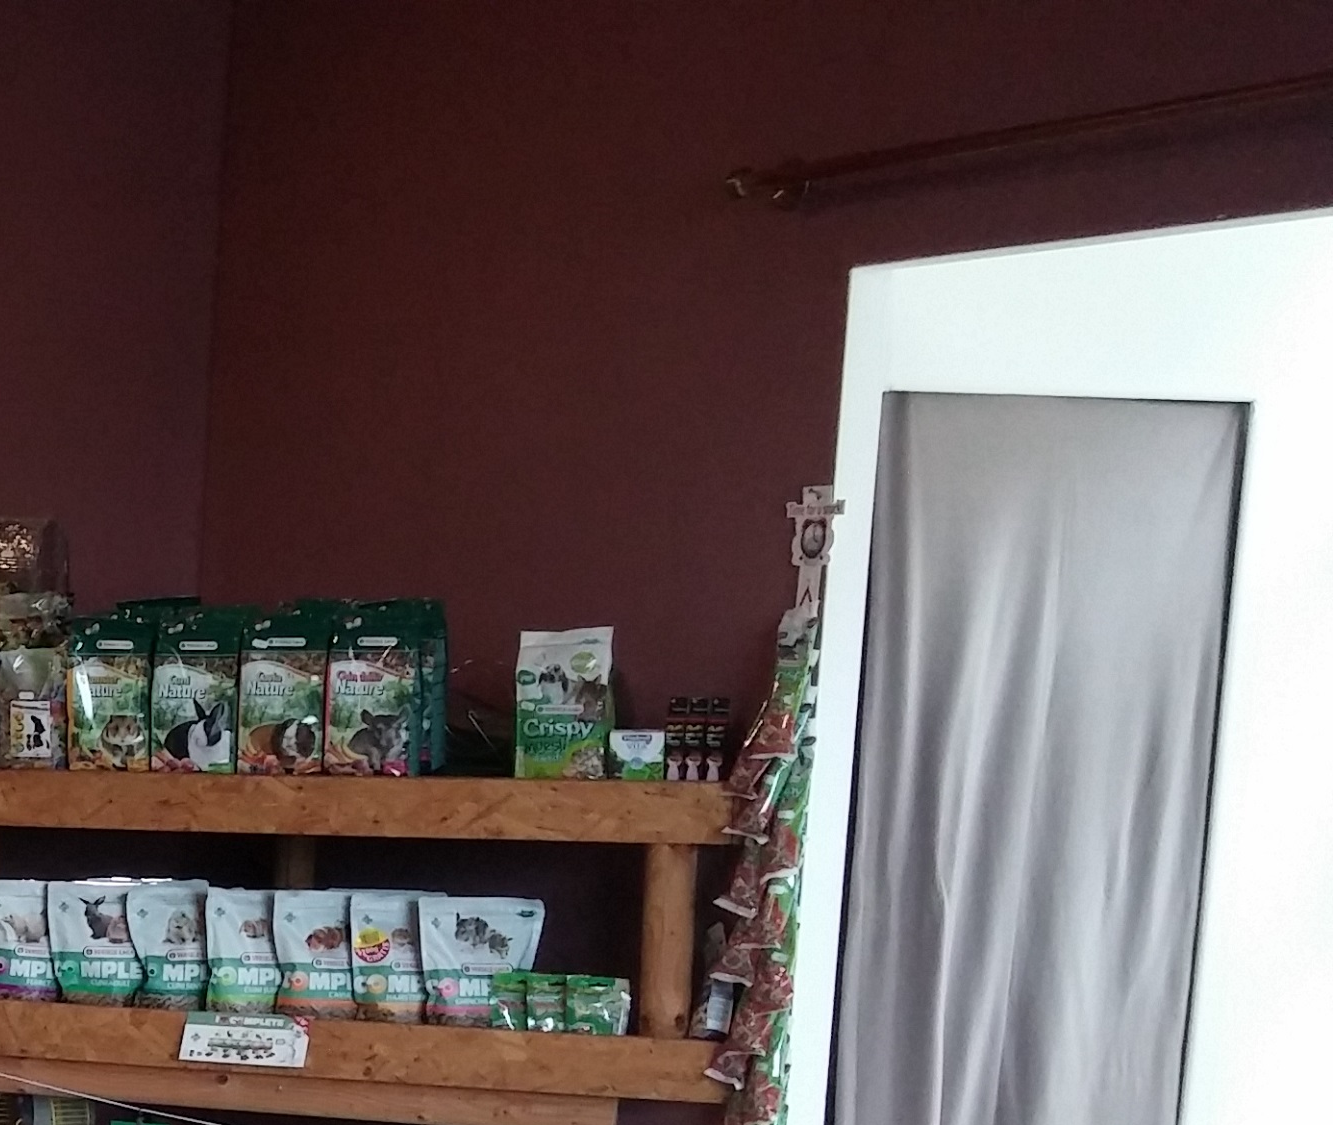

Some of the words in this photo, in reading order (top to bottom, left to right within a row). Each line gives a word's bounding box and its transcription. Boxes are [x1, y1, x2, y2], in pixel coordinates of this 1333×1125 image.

[158, 683, 206, 700] Nature
[246, 681, 294, 697] Nature
[335, 680, 384, 696] Nature
[523, 718, 595, 740] Crispy
